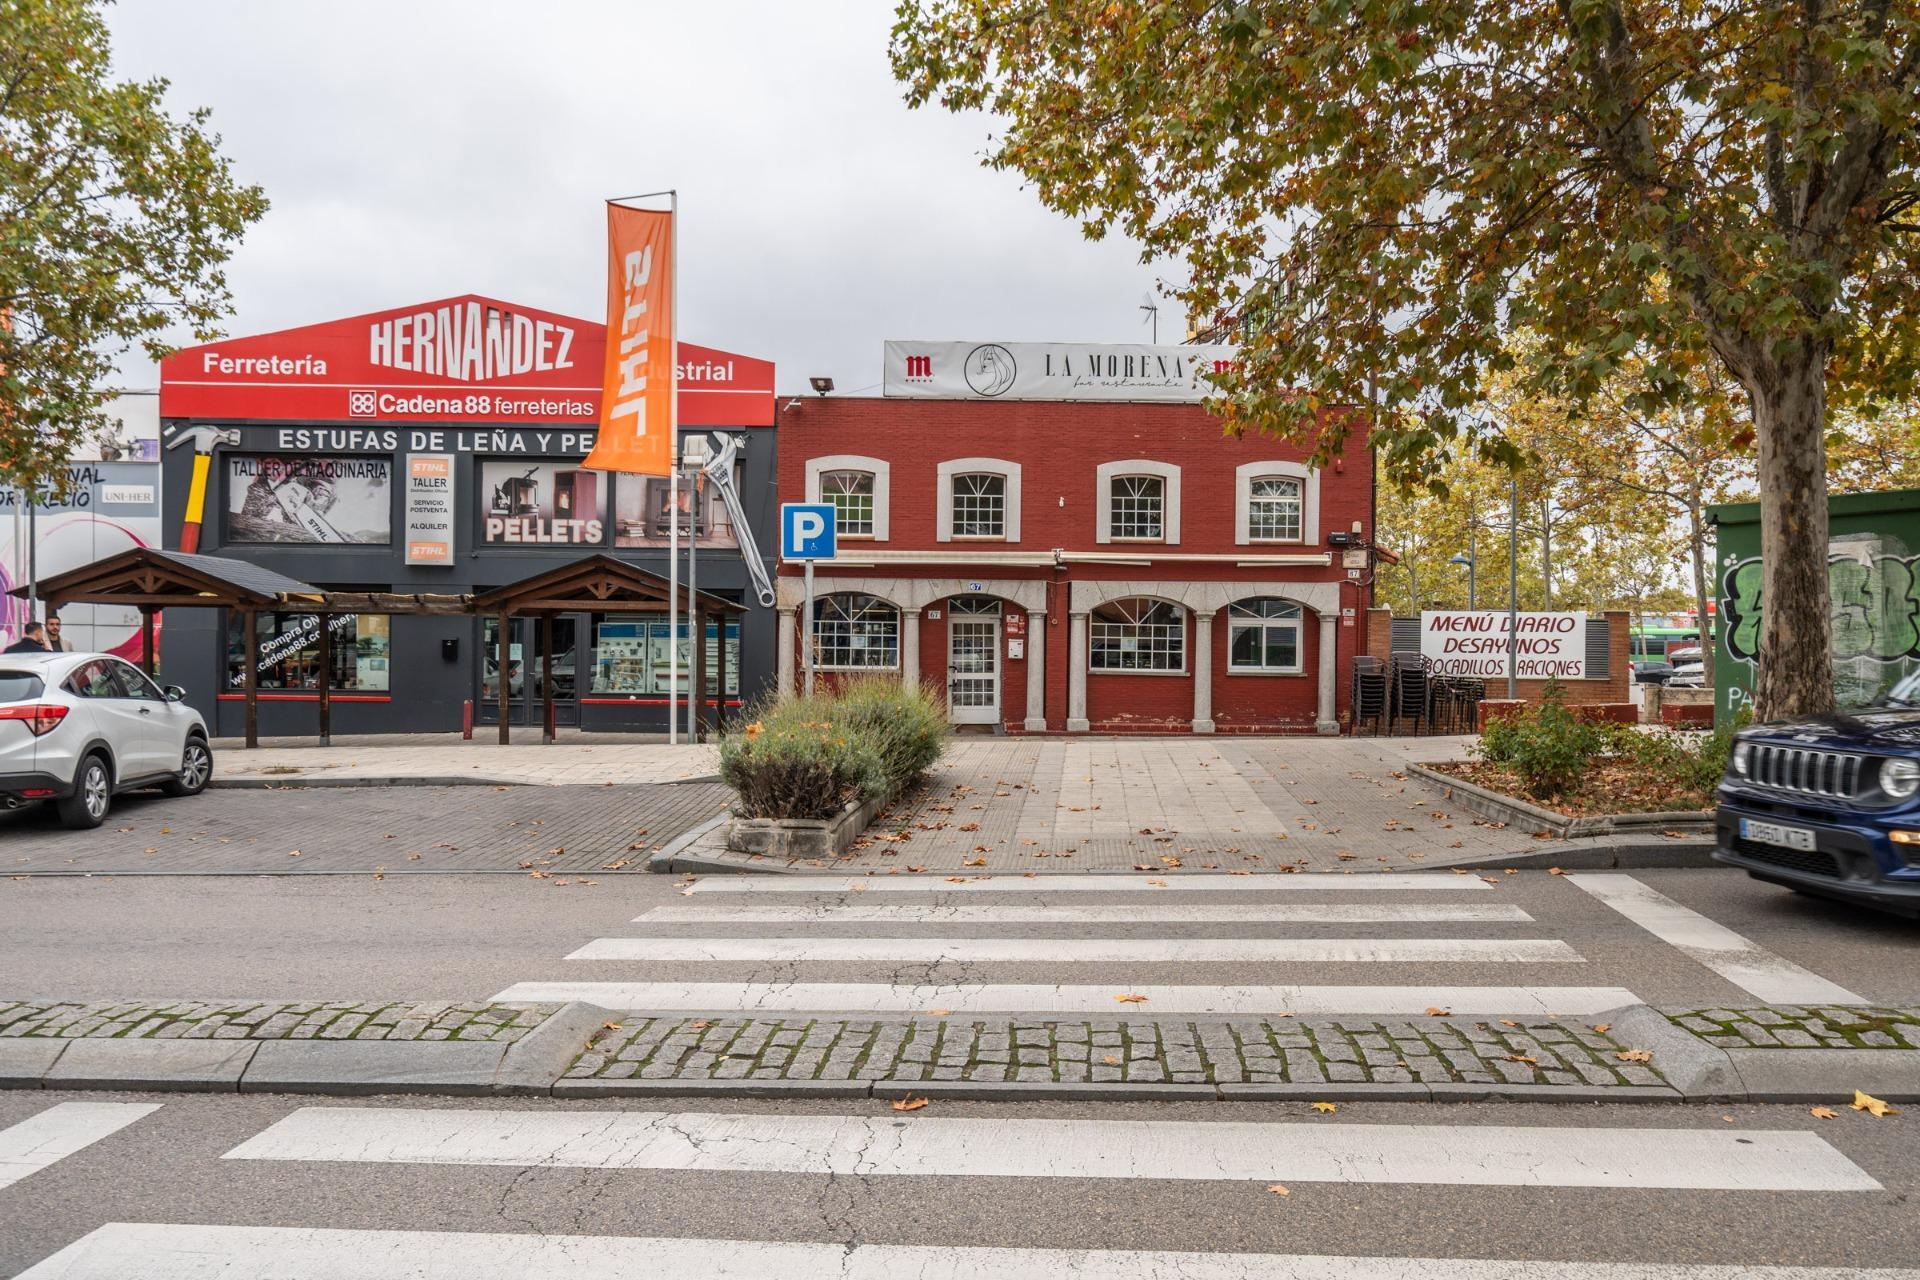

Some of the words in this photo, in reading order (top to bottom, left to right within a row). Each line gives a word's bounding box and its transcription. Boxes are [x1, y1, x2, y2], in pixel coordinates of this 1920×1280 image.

[370, 301, 575, 381] HERNANDEZ
[203, 353, 327, 376] Ferretería
[1045, 354, 1072, 377] LA
[1088, 354, 1183, 378] MORENA
[494, 397, 594, 416] ferreterias
[279, 430, 398, 451] ESTUFAS
[411, 431, 444, 451] DE
[457, 429, 527, 452] LEÑA
[536, 433, 552, 452] Y
[232, 460, 281, 477] TALLER
[284, 462, 300, 477] DE
[305, 462, 387, 478] MAQUINARIA
[413, 463, 447, 472] STIHL
[413, 478, 447, 488] TALLER
[104, 492, 152, 501] UNI-HER
[308, 518, 329, 541] STIHL
[486, 518, 604, 544] PELLETS
[793, 512, 825, 552] P
[412, 546, 446, 555] STIHL
[970, 583, 982, 591] 67
[1430, 613, 1494, 632] MENÚ
[260, 626, 303, 655] Compra
[302, 613, 321, 630] ON
[1517, 659, 1582, 676] RACIONES
[1728, 687, 1753, 711] PA
